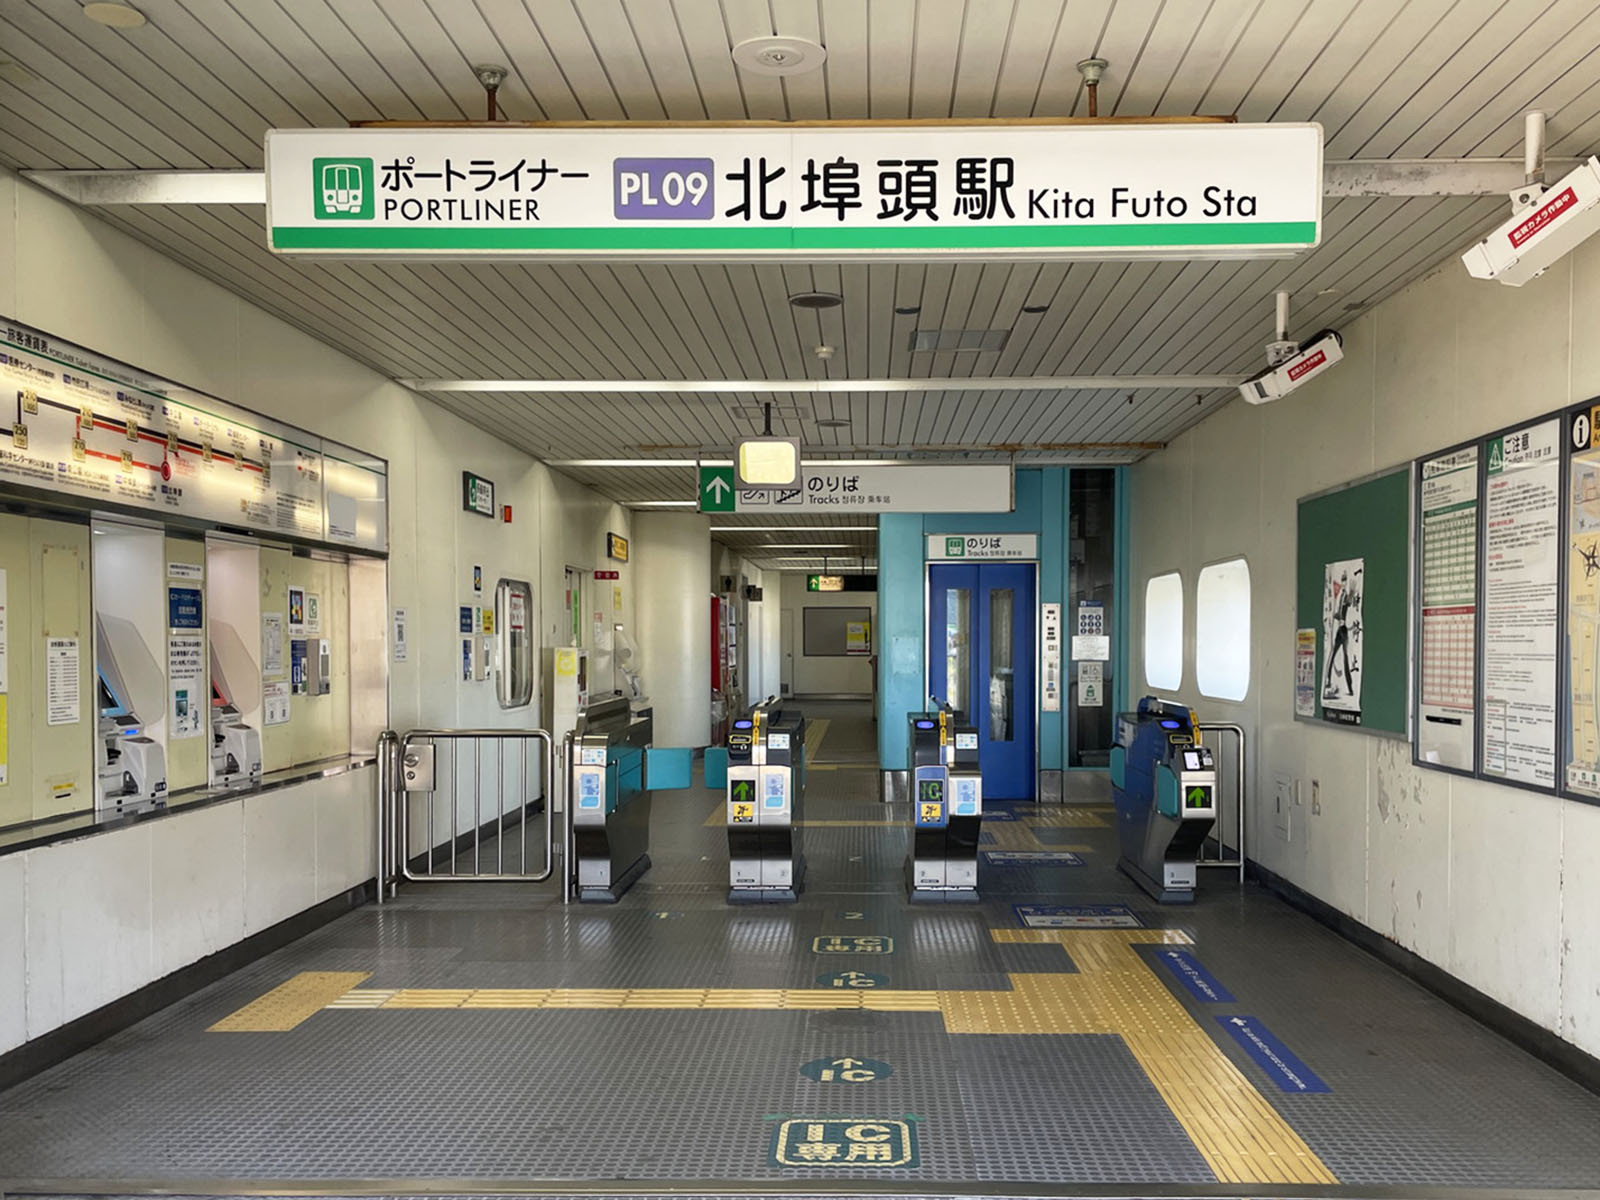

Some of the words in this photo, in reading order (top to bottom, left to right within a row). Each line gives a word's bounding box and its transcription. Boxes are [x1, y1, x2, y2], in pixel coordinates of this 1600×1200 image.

[380, 156, 590, 192] ポートライナー
[724, 156, 1017, 222] 北埠頭駅
[384, 198, 540, 222] PORTLINER
[1027, 188, 1096, 220] Kita
[1111, 187, 1188, 219] Futo
[1202, 185, 1258, 217] Sta
[807, 475, 860, 493] のりば
[808, 494, 840, 505] Tracks
[966, 536, 1002, 549] のりば
[830, 937, 882, 945] IC
[832, 979, 876, 988] IC
[820, 1069, 876, 1083] IC
[807, 1123, 892, 1142] IC
[792, 1142, 893, 1162] 専用
